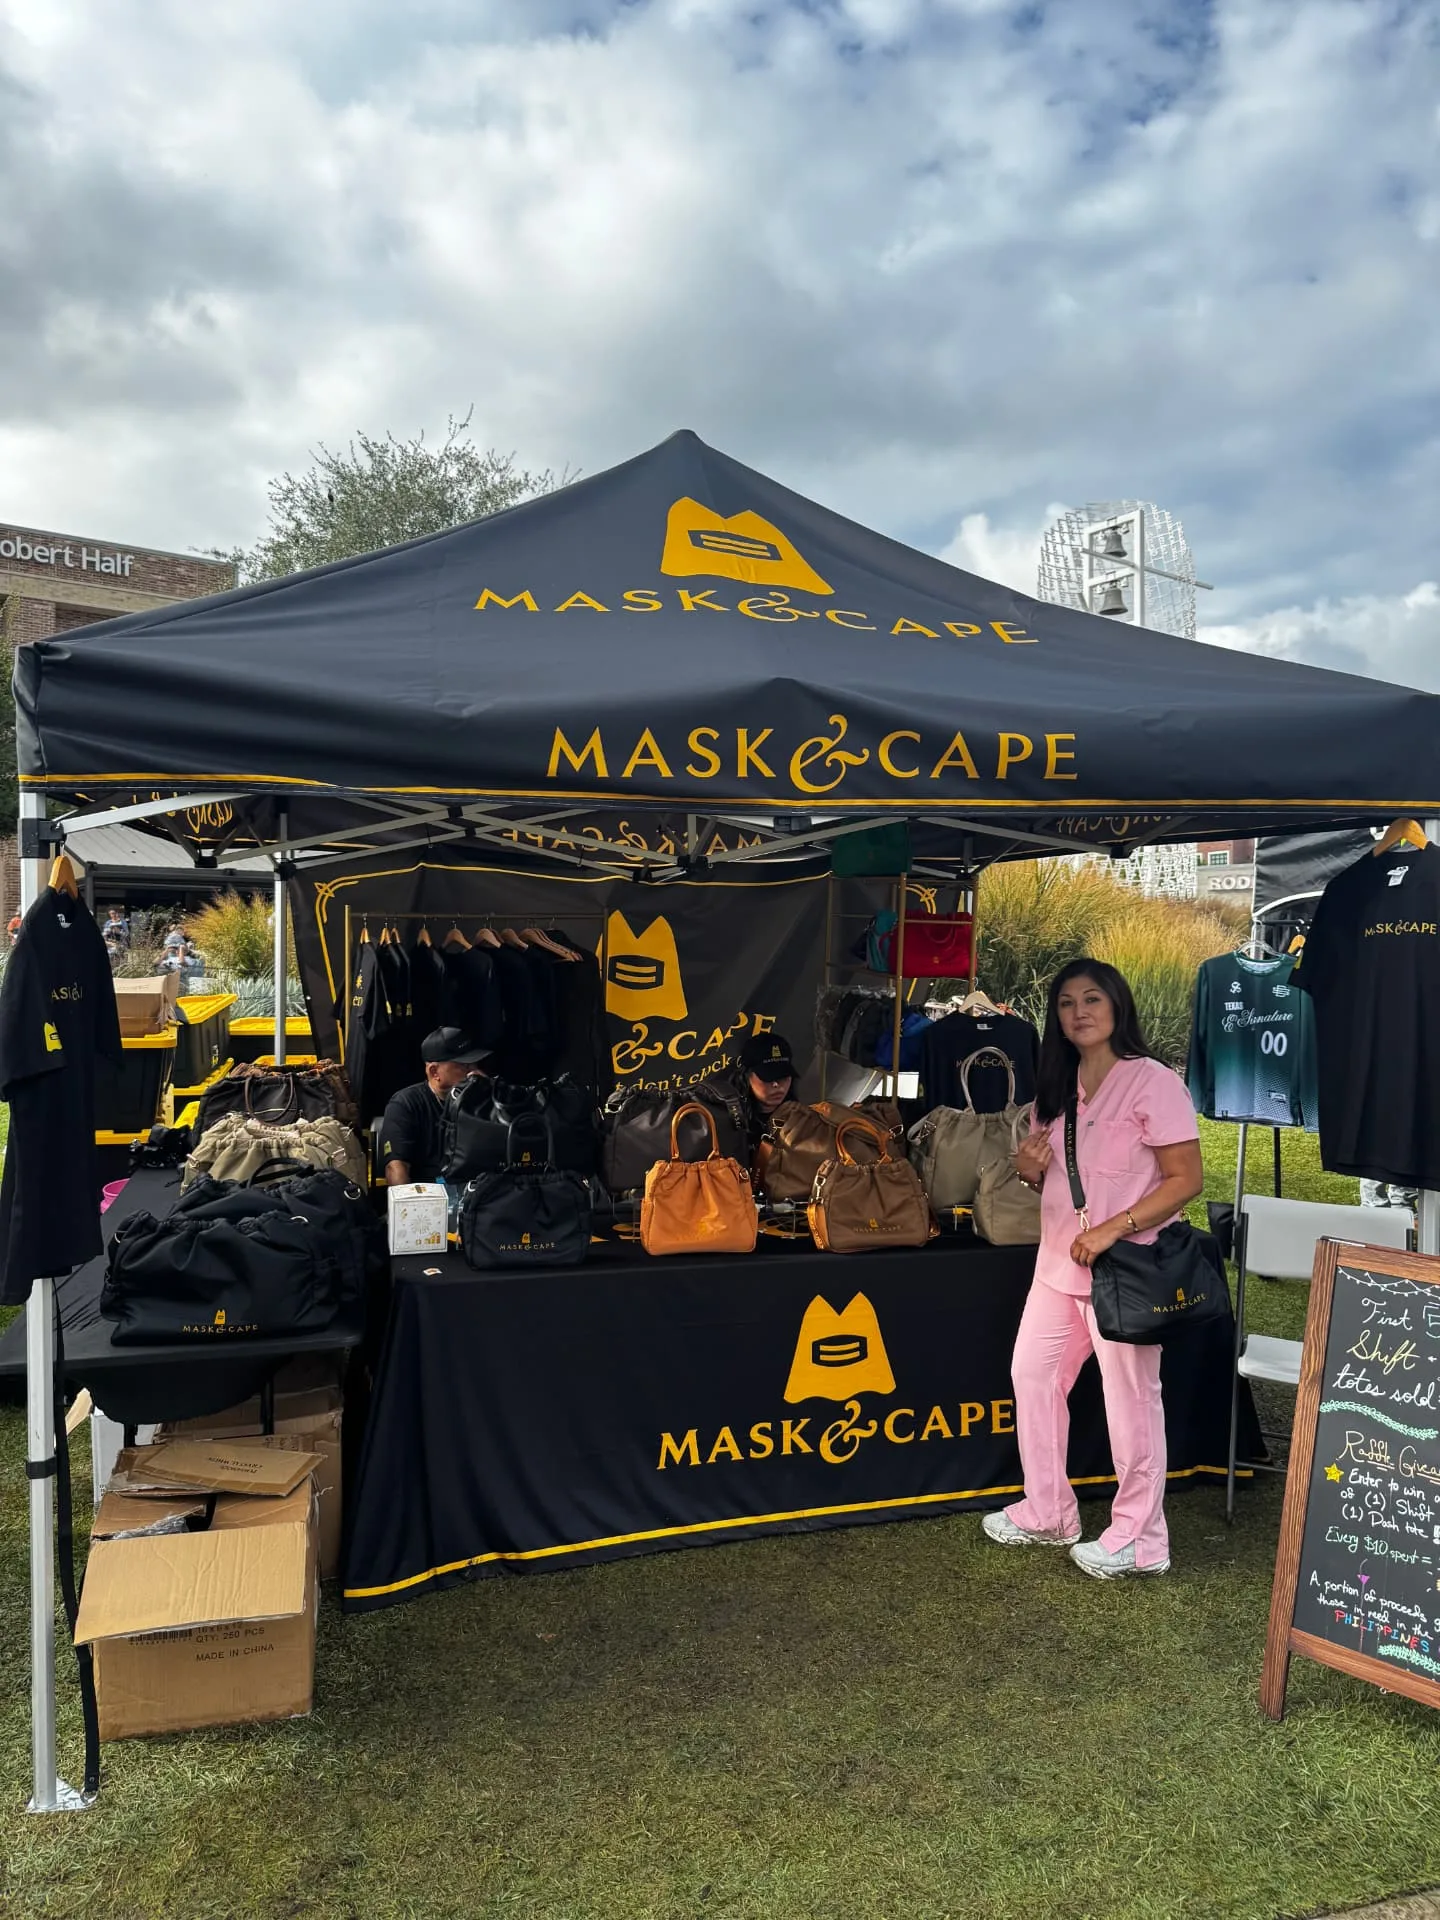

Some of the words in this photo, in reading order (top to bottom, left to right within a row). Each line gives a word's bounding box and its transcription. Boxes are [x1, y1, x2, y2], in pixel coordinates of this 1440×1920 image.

[0, 536, 74, 568] obert
[81, 547, 135, 577] Half
[1261, 1030, 1288, 1057] 00
[1361, 1297, 1413, 1331] First
[1346, 1329, 1421, 1375] Shift
[1331, 1362, 1386, 1396] totes
[1335, 1431, 1396, 1466] Raffle
[1348, 1467, 1383, 1488] Enter
[1388, 1477, 1399, 1491] to
[1403, 1485, 1426, 1501] win
[1340, 1486, 1356, 1499] of
[1364, 1490, 1386, 1512] (1)
[1395, 1498, 1435, 1523] Shift
[1341, 1503, 1364, 1522] (1)
[1367, 1510, 1400, 1533] Dash
[1405, 1521, 1429, 1538] tote
[1325, 1526, 1359, 1553] Every
[1363, 1534, 1389, 1555] $10
[1389, 1549, 1420, 1564] spent
[1309, 1570, 1321, 1587] A
[1324, 1579, 1359, 1597] portion
[1363, 1589, 1377, 1603] of
[1379, 1598, 1428, 1623] proceeds
[244, 1626, 265, 1637] PCS
[1316, 1592, 1348, 1609] those
[1353, 1604, 1365, 1617] in
[1367, 1610, 1390, 1624] need
[1396, 1619, 1407, 1631] in
[1411, 1623, 1434, 1641] the
[1334, 1609, 1430, 1653] PHILIPPINES
[196, 1651, 225, 1662] MADE
[229, 1648, 239, 1657] IN
[243, 1642, 274, 1655] CHINA
